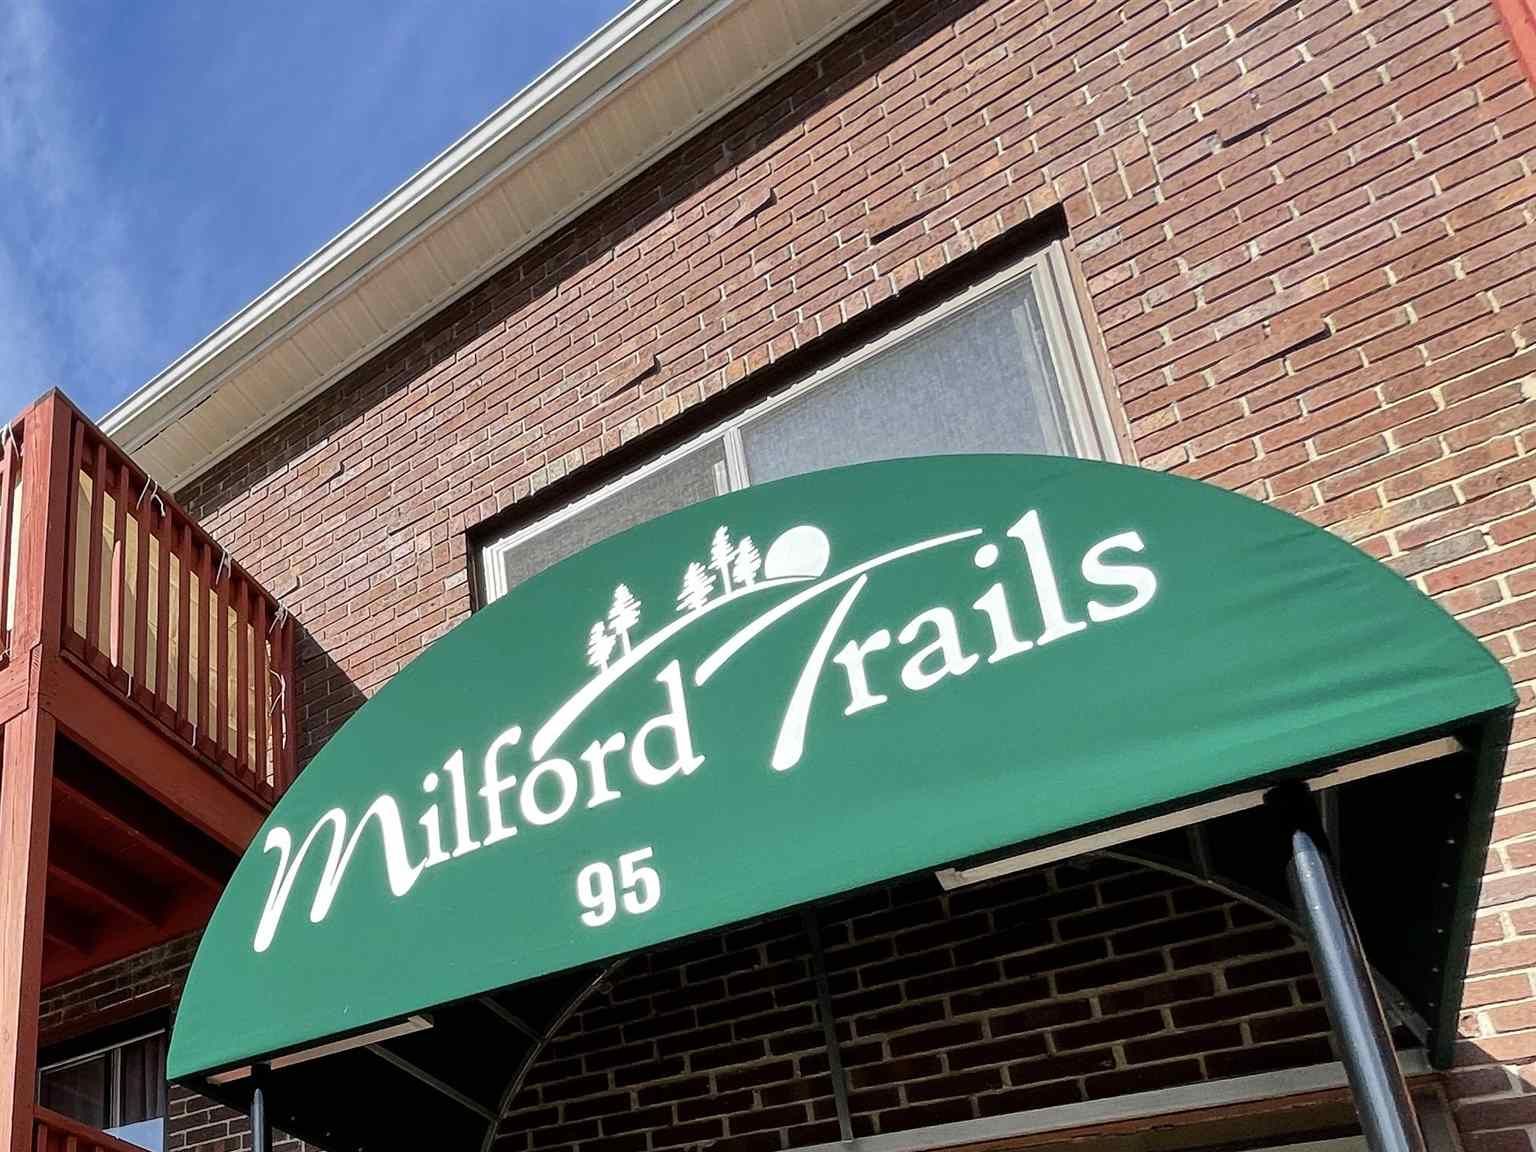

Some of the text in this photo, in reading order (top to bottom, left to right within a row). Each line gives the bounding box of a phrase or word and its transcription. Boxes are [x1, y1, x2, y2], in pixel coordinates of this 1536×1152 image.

[252, 509, 1160, 953] Milford Trails
[575, 845, 663, 928] 95
